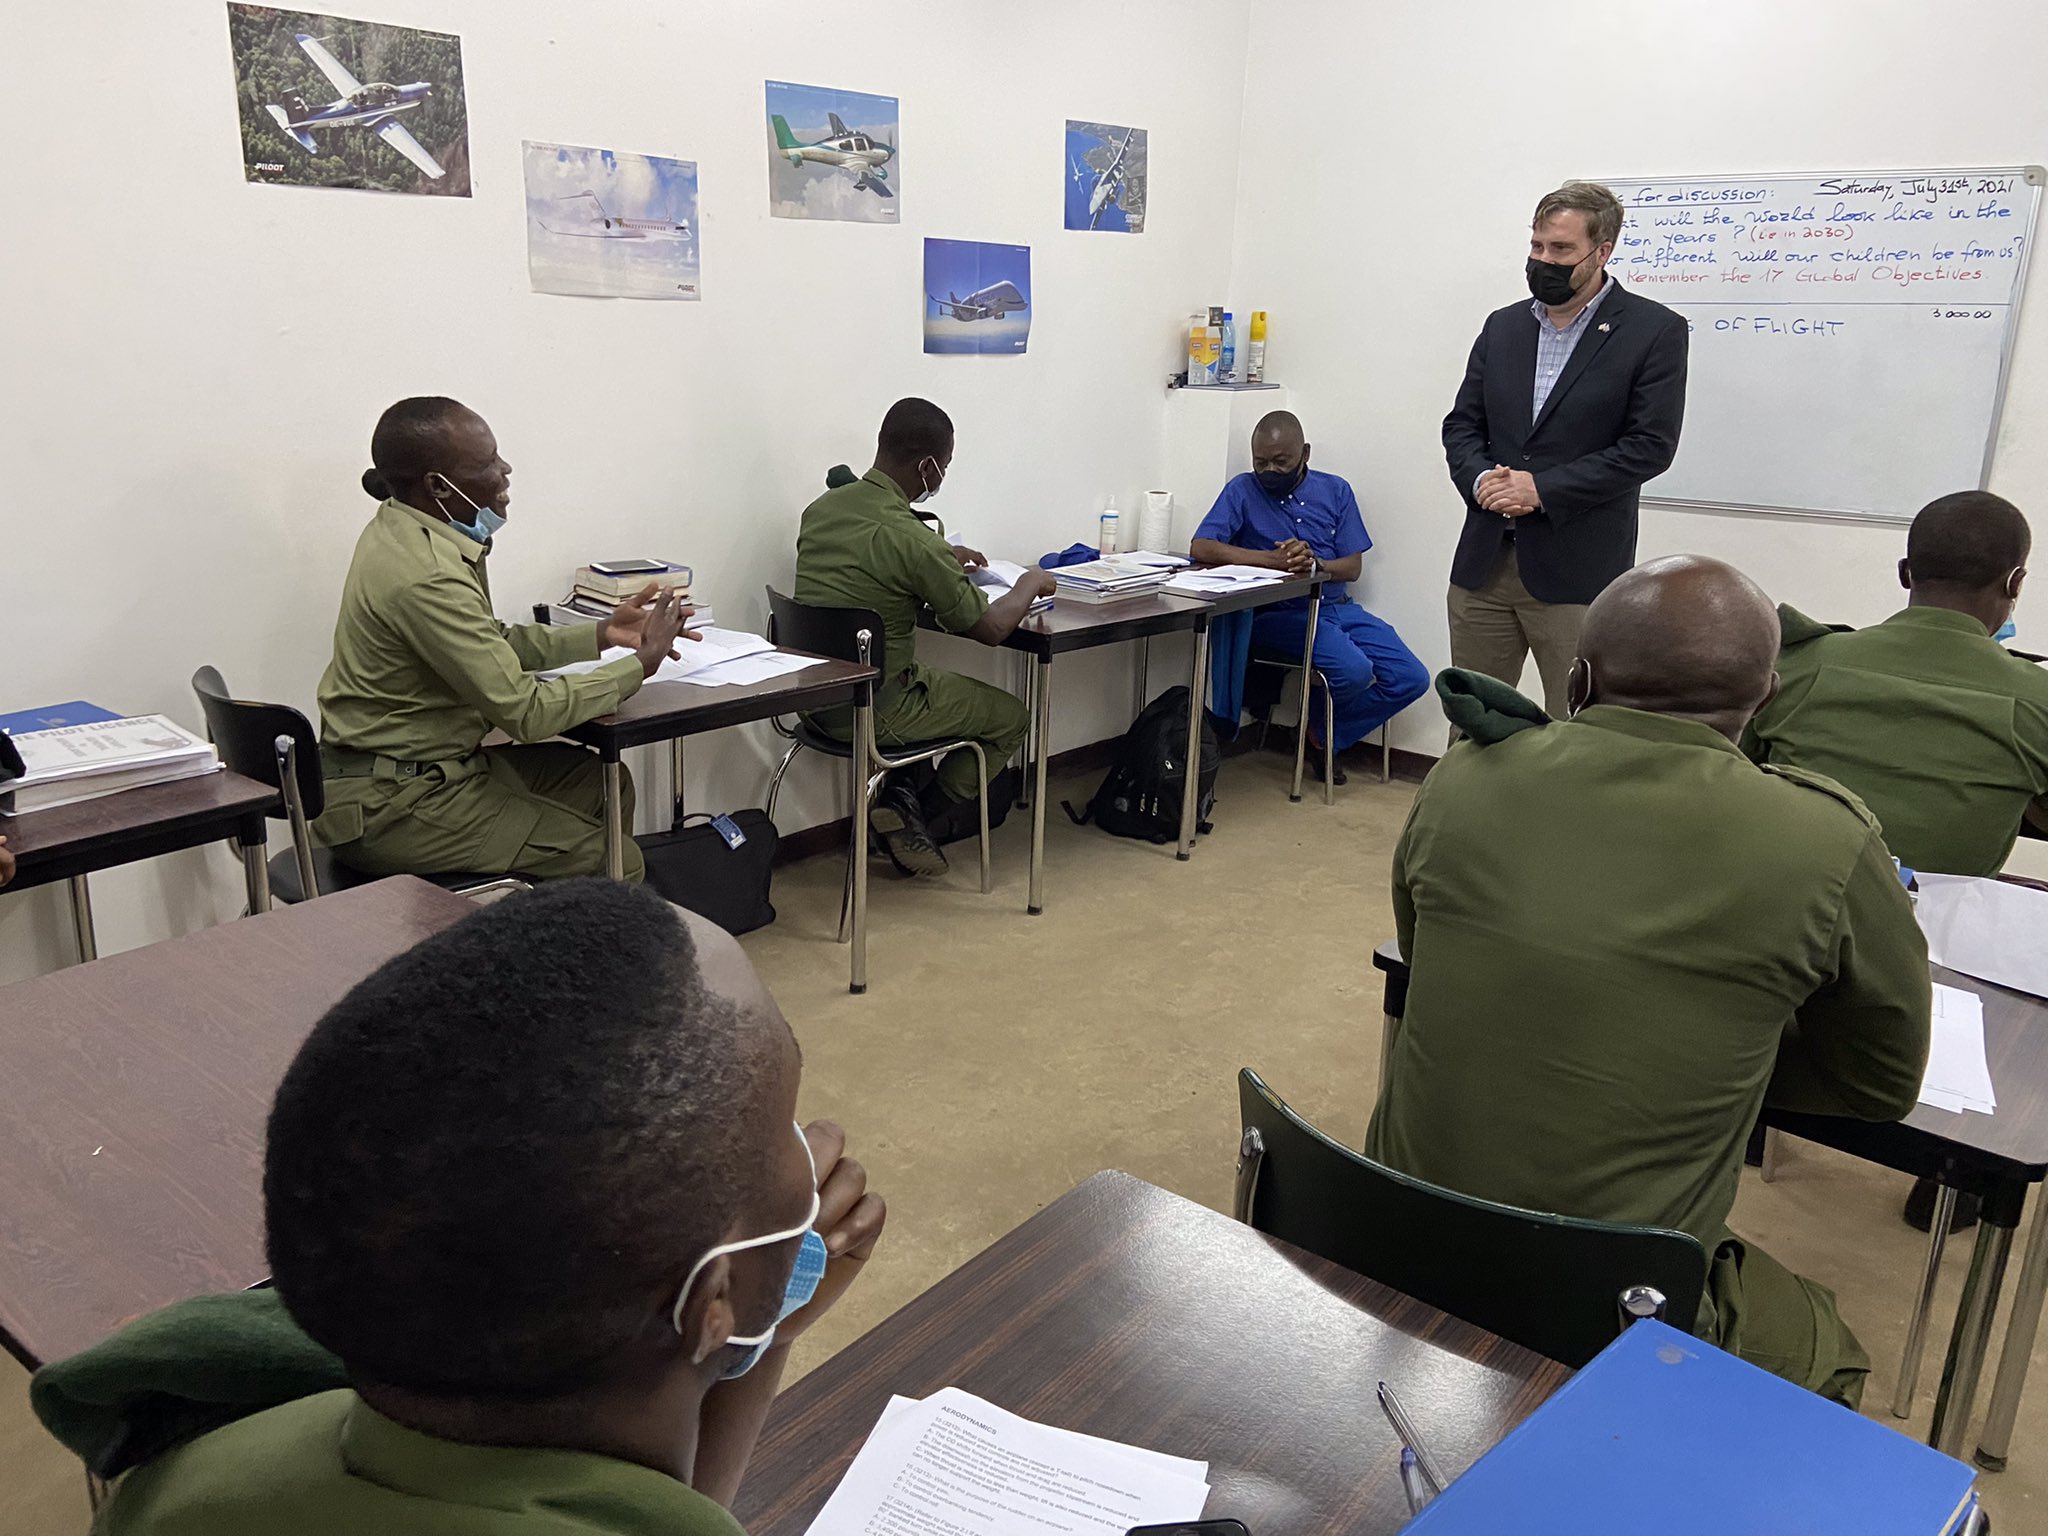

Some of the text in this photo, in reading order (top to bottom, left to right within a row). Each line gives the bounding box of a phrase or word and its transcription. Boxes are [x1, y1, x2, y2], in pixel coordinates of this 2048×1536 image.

[1632, 188, 1662, 207] for
[1668, 188, 1775, 202] discussion:
[1814, 178, 1894, 202] Saturday,
[1977, 178, 2014, 194] 2021
[1654, 210, 1694, 227] will
[1703, 207, 1734, 225] the
[1825, 202, 1876, 222] look
[1884, 202, 1935, 221] like
[1948, 206, 1971, 220] in
[1976, 200, 2012, 218] the
[1622, 233, 1652, 247] ten
[1663, 232, 1717, 250] years
[1784, 230, 1796, 240] in
[1802, 224, 1855, 242] 2030)
[1631, 247, 1718, 268] different
[1784, 252, 1819, 263] our
[1831, 246, 1921, 262] children
[1932, 242, 1954, 261] be
[1960, 239, 1995, 263] from
[1626, 268, 1711, 284] Remember
[1720, 267, 1752, 284] the
[1760, 268, 1784, 284] 17
[1795, 267, 1860, 284] Global
[1714, 316, 1747, 332] OF
[1753, 317, 1845, 336] FLIGHT
[38, 726, 86, 739] PILOT
[90, 716, 157, 732] LICENCE
[941, 1406, 997, 1434] AERODYNAMICS
